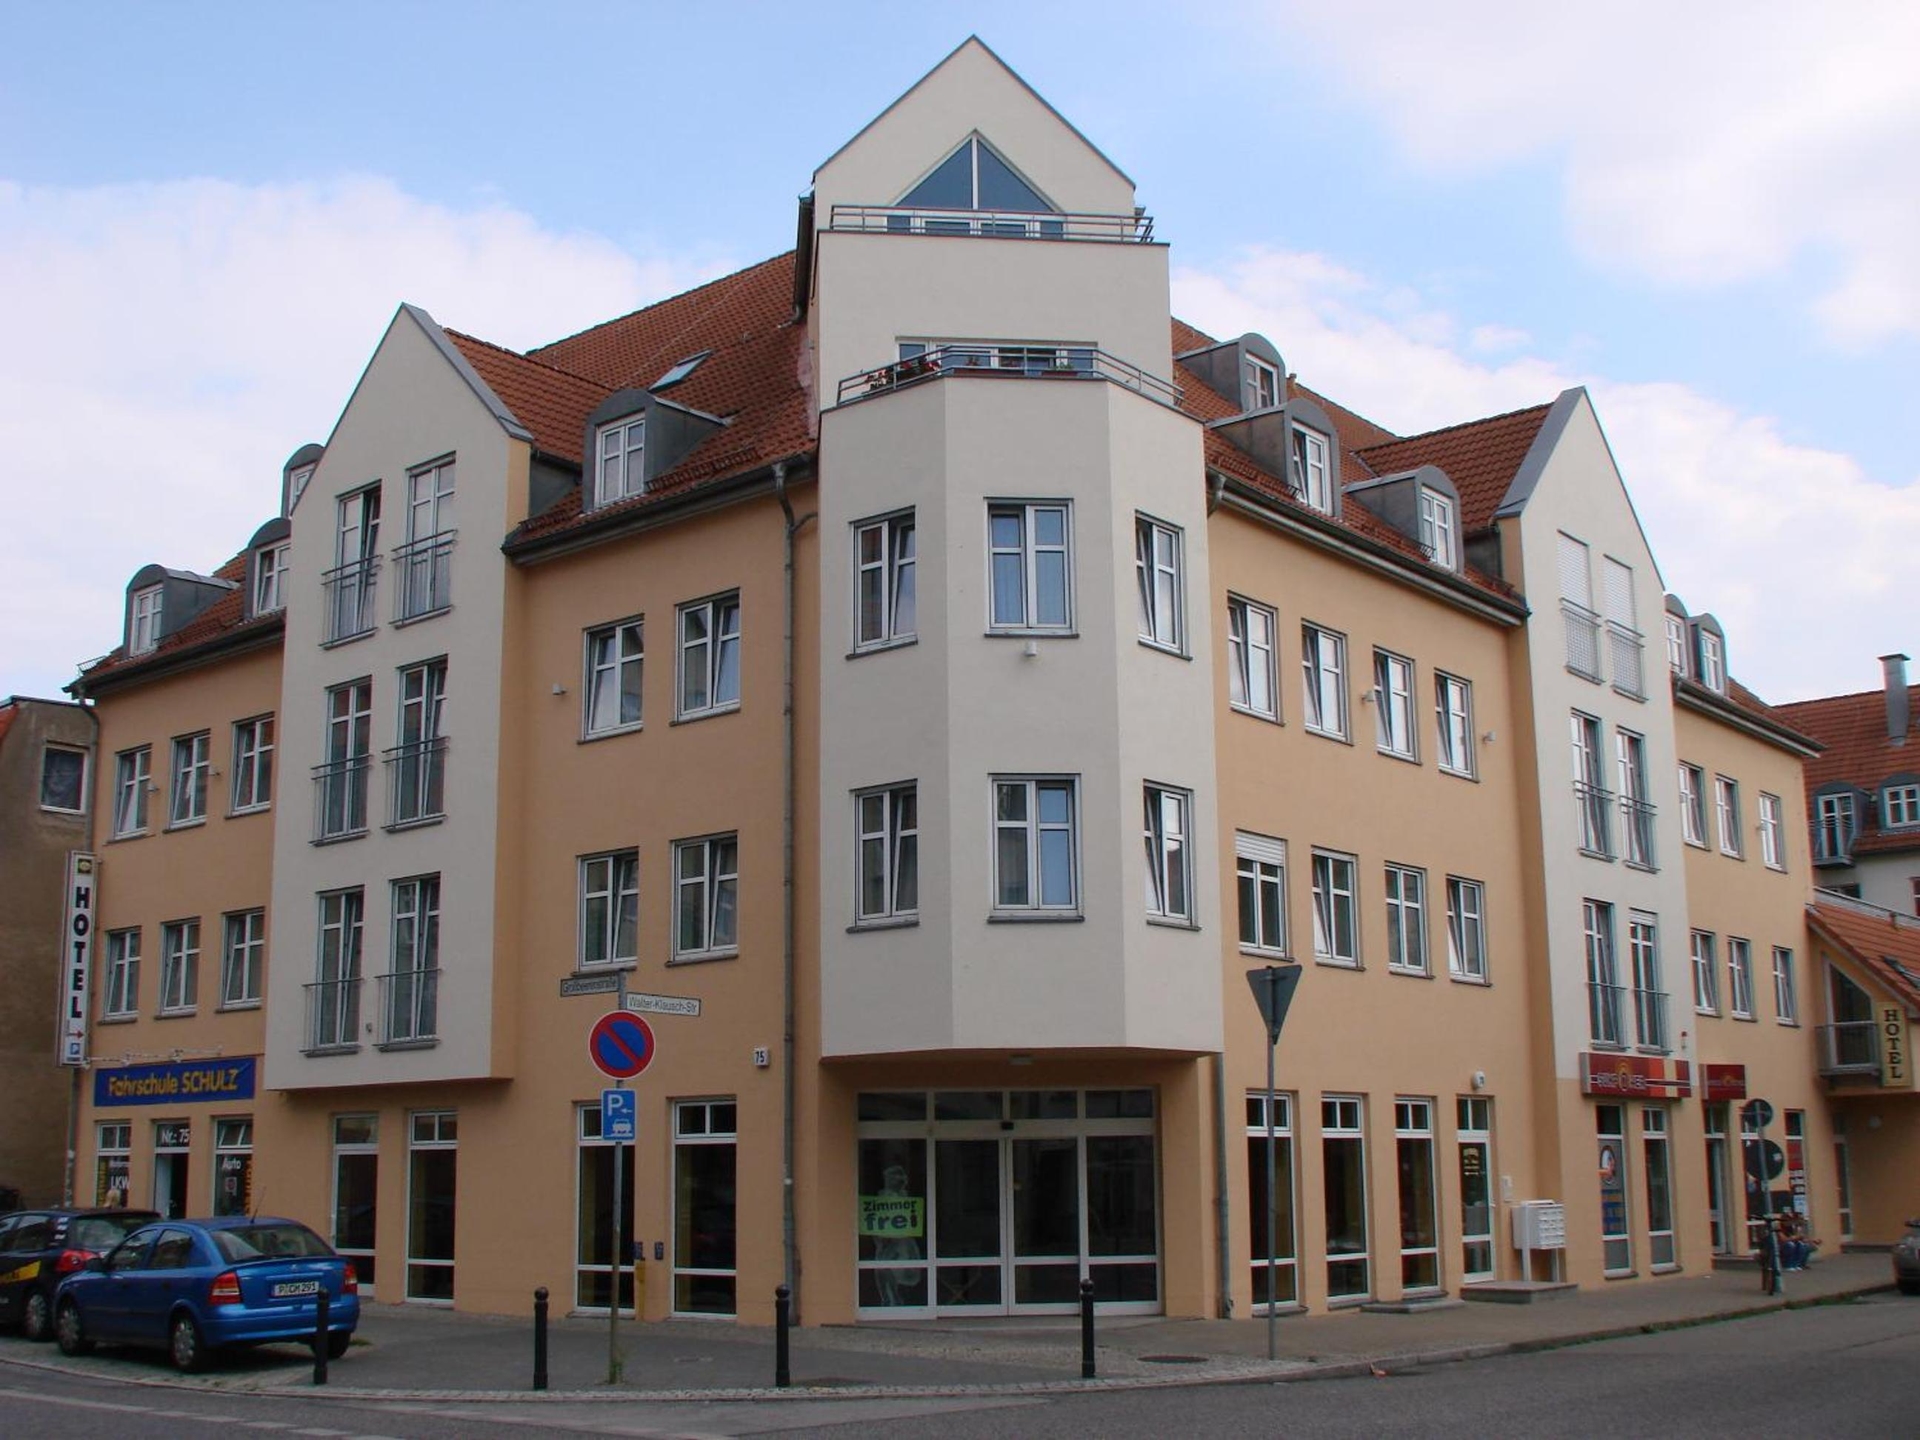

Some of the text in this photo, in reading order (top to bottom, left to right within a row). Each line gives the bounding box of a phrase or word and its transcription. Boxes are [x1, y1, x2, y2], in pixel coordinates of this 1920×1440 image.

[71, 887, 90, 1018] HOTEL
[1884, 1009, 1902, 1079] HOTEL
[755, 1051, 765, 1063] 75
[109, 1068, 239, 1096] Fahrschule SCHULZ
[607, 1094, 624, 1116] P
[222, 1157, 241, 1170] Auto
[863, 1200, 917, 1212] Zimmer
[864, 1209, 918, 1231] frei
